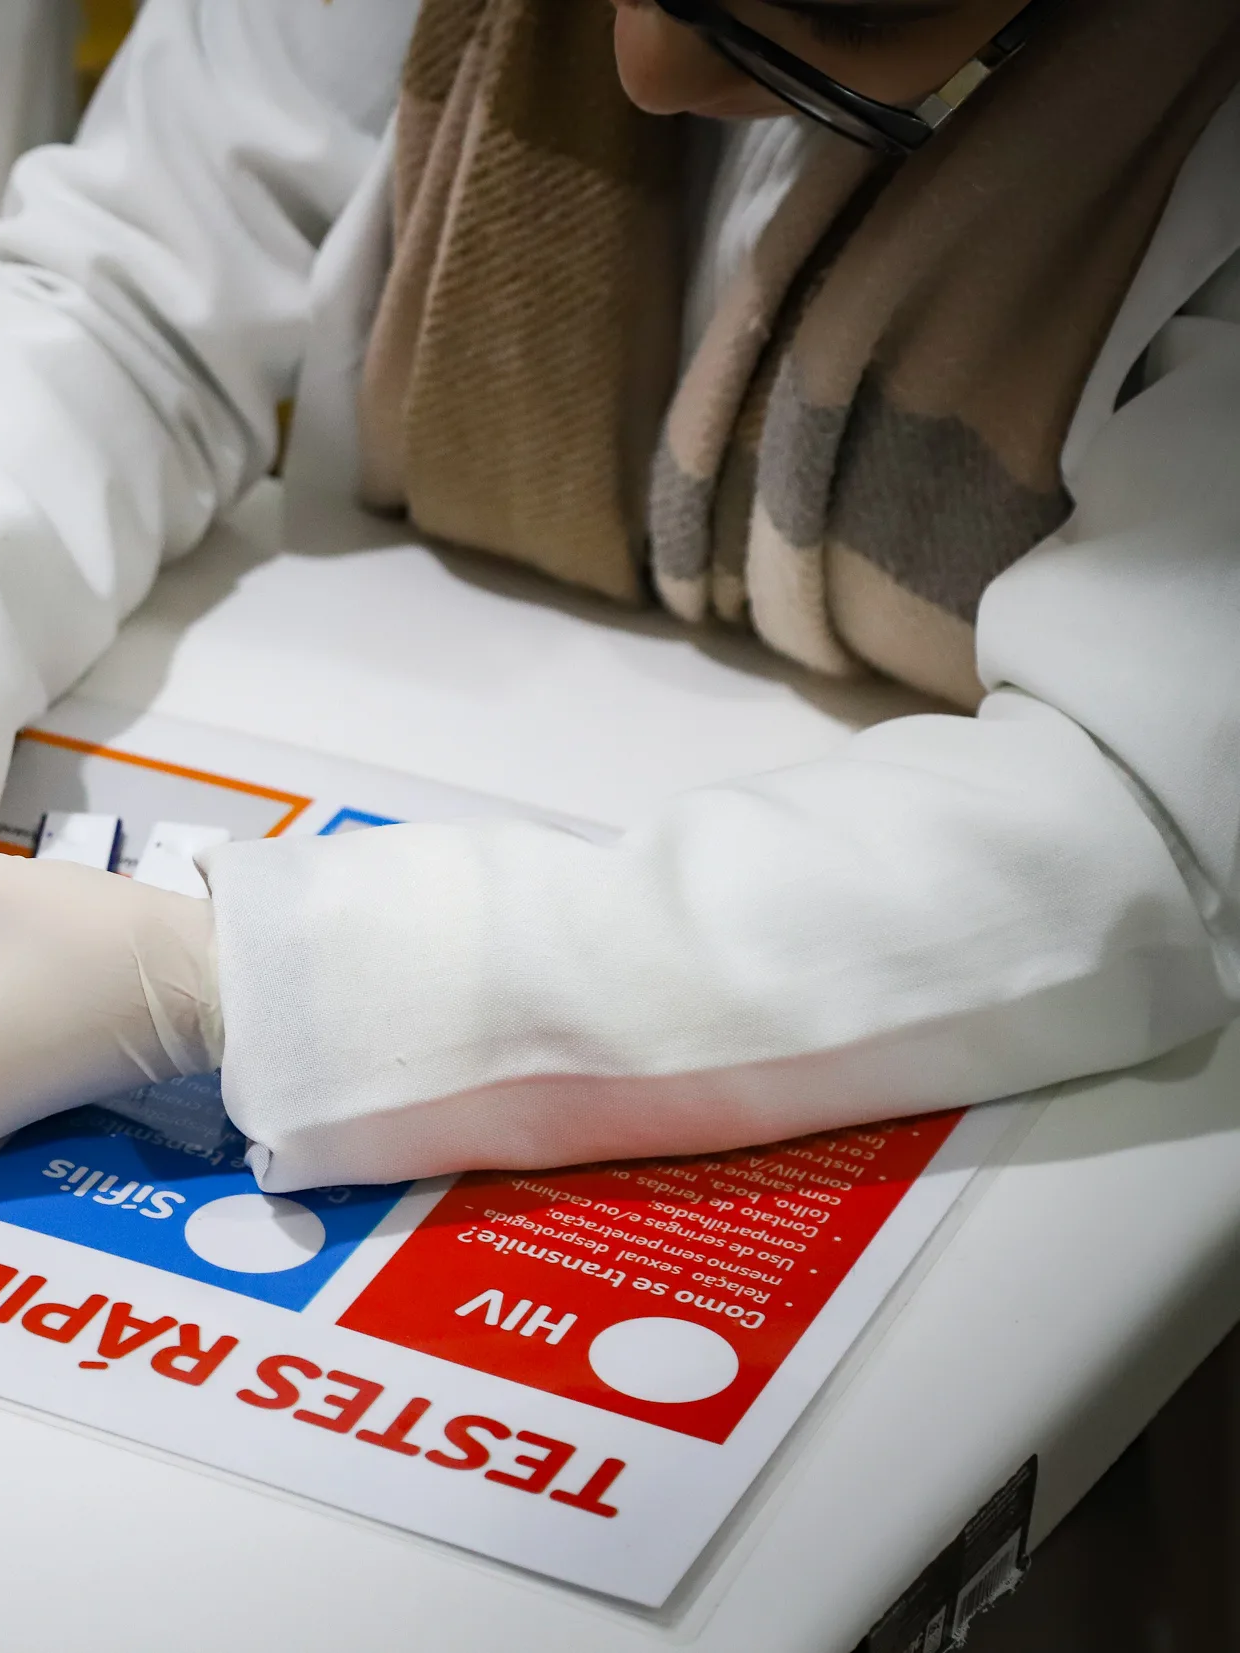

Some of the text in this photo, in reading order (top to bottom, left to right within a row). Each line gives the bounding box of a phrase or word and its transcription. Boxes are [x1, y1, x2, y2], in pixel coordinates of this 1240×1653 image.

[718, 1164, 796, 1193] sangue
[748, 1156, 853, 1192] com HIV/A
[784, 1147, 866, 1178] Instrum
[41, 1158, 187, 1220] Sífilis
[635, 1175, 705, 1205] feridas
[708, 1198, 736, 1213] de
[709, 1178, 762, 1204] boca,
[797, 1187, 843, 1207] com
[481, 1208, 610, 1256] desprotegida
[510, 1178, 795, 1272] Uso de seringas e/ou cachimb
[647, 1198, 808, 1254] compartilhados;
[739, 1206, 820, 1239] Contato
[544, 1207, 783, 1287] mesmo sem penetração;
[614, 1249, 684, 1276] sexual
[456, 1225, 767, 1330] Como se transmite?
[689, 1270, 772, 1304] Relação
[452, 1287, 578, 1346] HIV
[237, 1355, 625, 1518] TESTES
